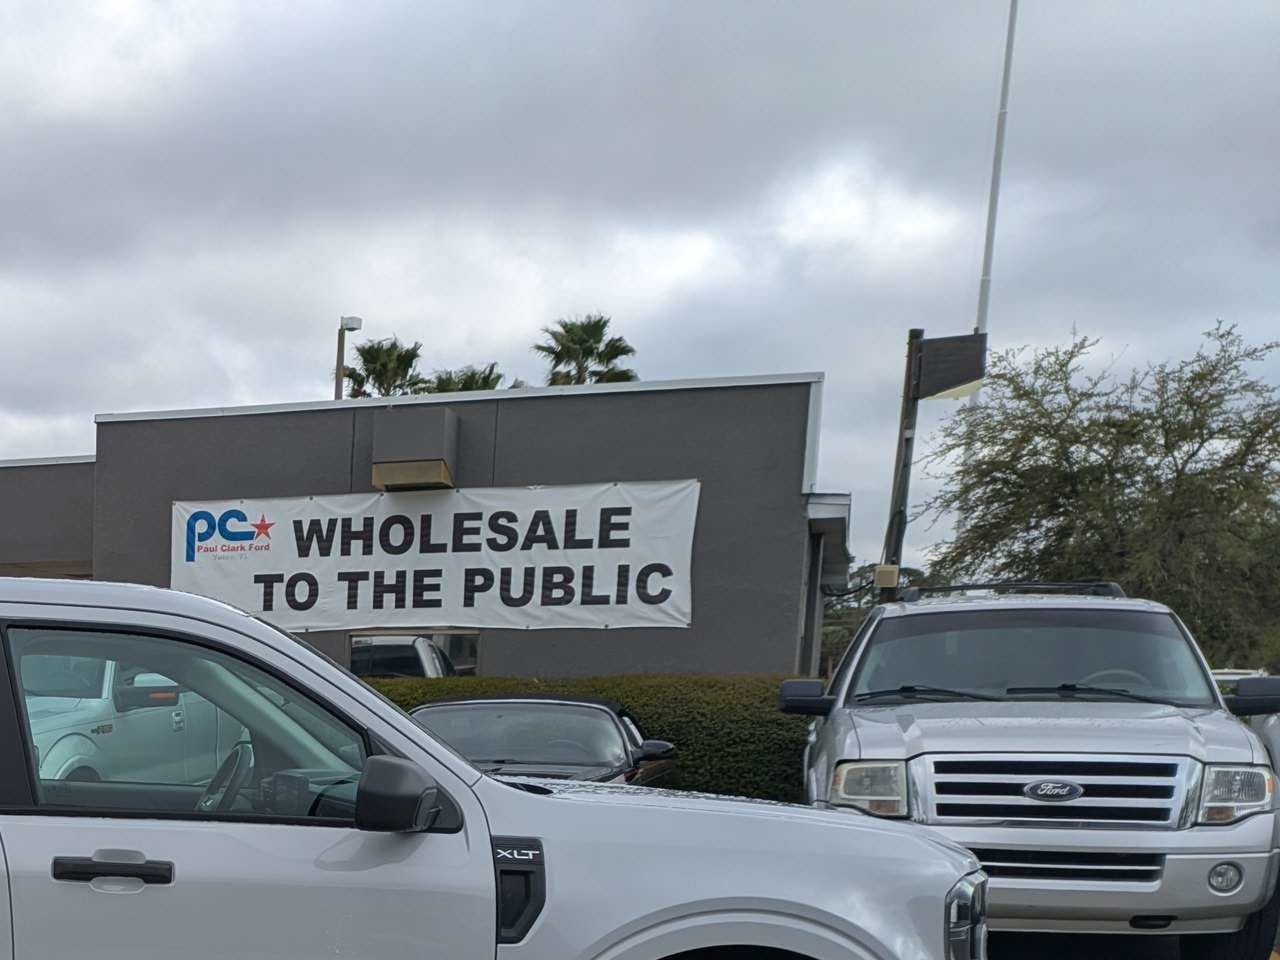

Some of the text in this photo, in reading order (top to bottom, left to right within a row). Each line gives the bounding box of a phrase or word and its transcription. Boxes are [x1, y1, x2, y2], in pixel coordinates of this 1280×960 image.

[293, 506, 632, 558] WHOLESALE
[197, 543, 270, 553] Paul Clark Ford
[254, 562, 674, 611] TO THE PUBLIC
[1037, 782, 1071, 795] Ford
[496, 849, 540, 859] XLT
